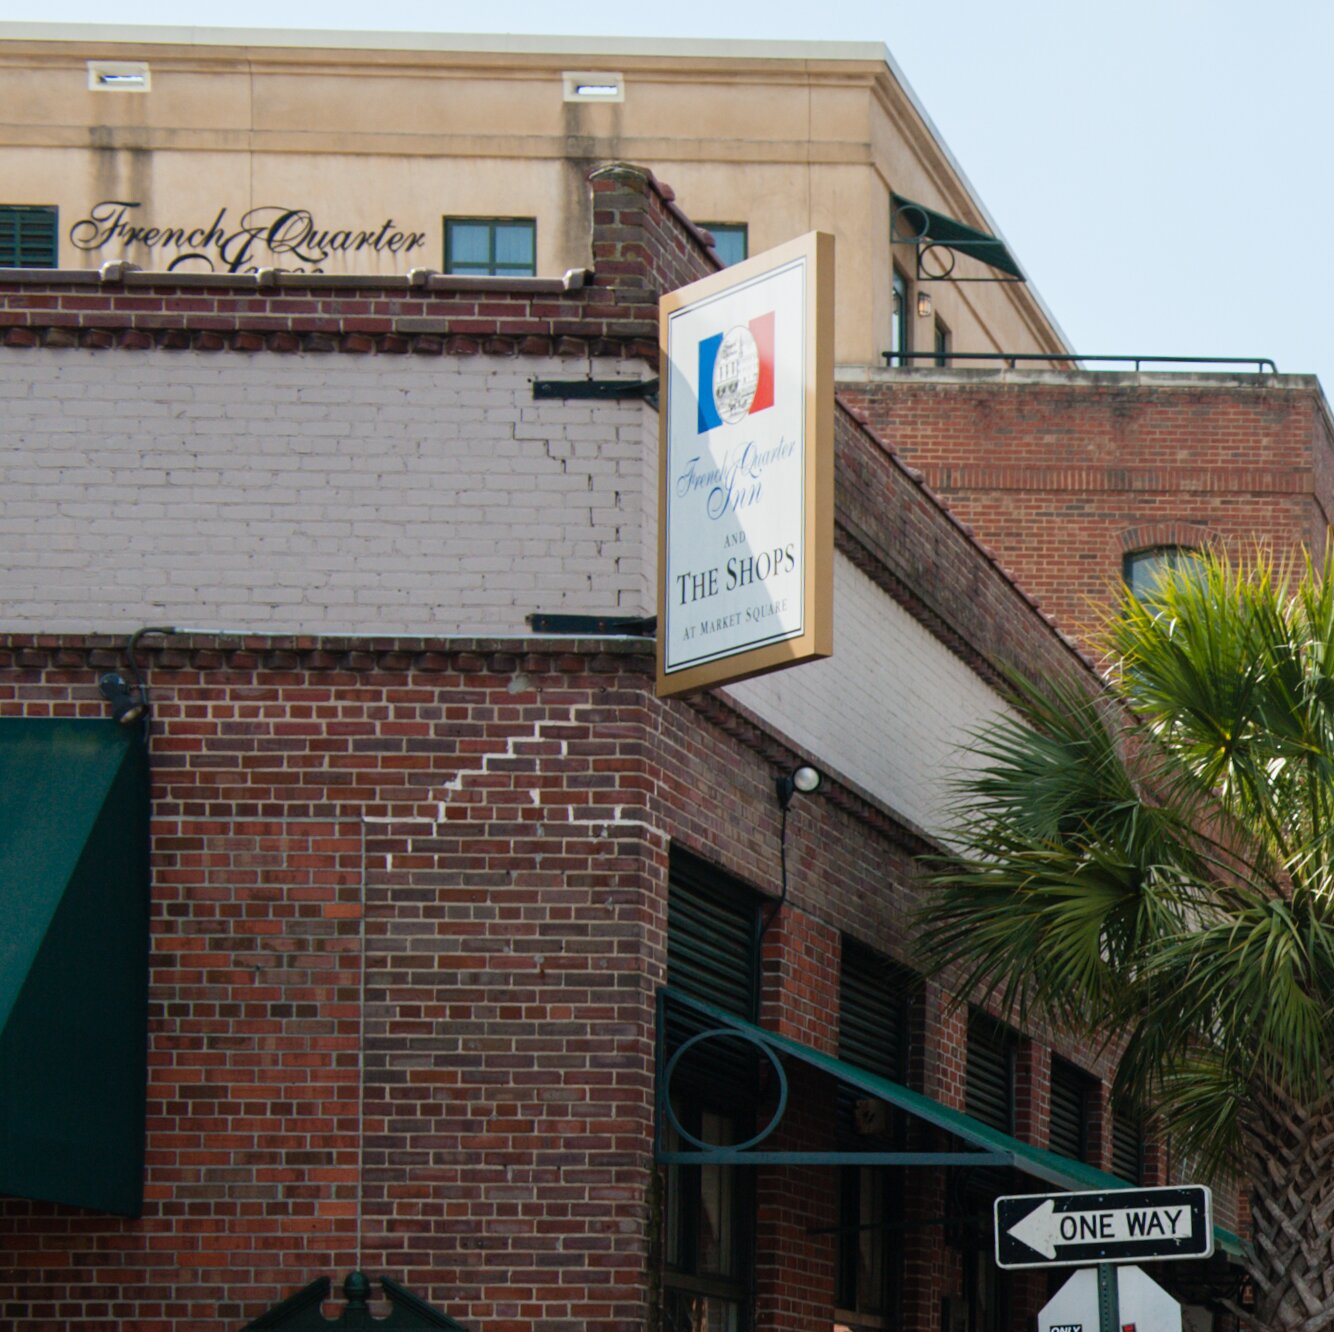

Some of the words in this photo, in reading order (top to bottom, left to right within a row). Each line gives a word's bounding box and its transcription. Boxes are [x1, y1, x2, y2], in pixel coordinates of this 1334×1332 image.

[69, 200, 225, 251] French
[241, 206, 425, 263] Quarter
[677, 451, 729, 498] French
[734, 435, 796, 479] Quarter
[707, 462, 762, 520] Inn
[724, 530, 746, 549] AND
[676, 567, 719, 606] THE
[726, 543, 795, 591] SHOPS
[683, 626, 697, 641] AT
[700, 612, 741, 636] MARKET
[745, 598, 788, 622] SQUARE
[1059, 1213, 1116, 1242] ONE
[1126, 1209, 1183, 1238] WAY
